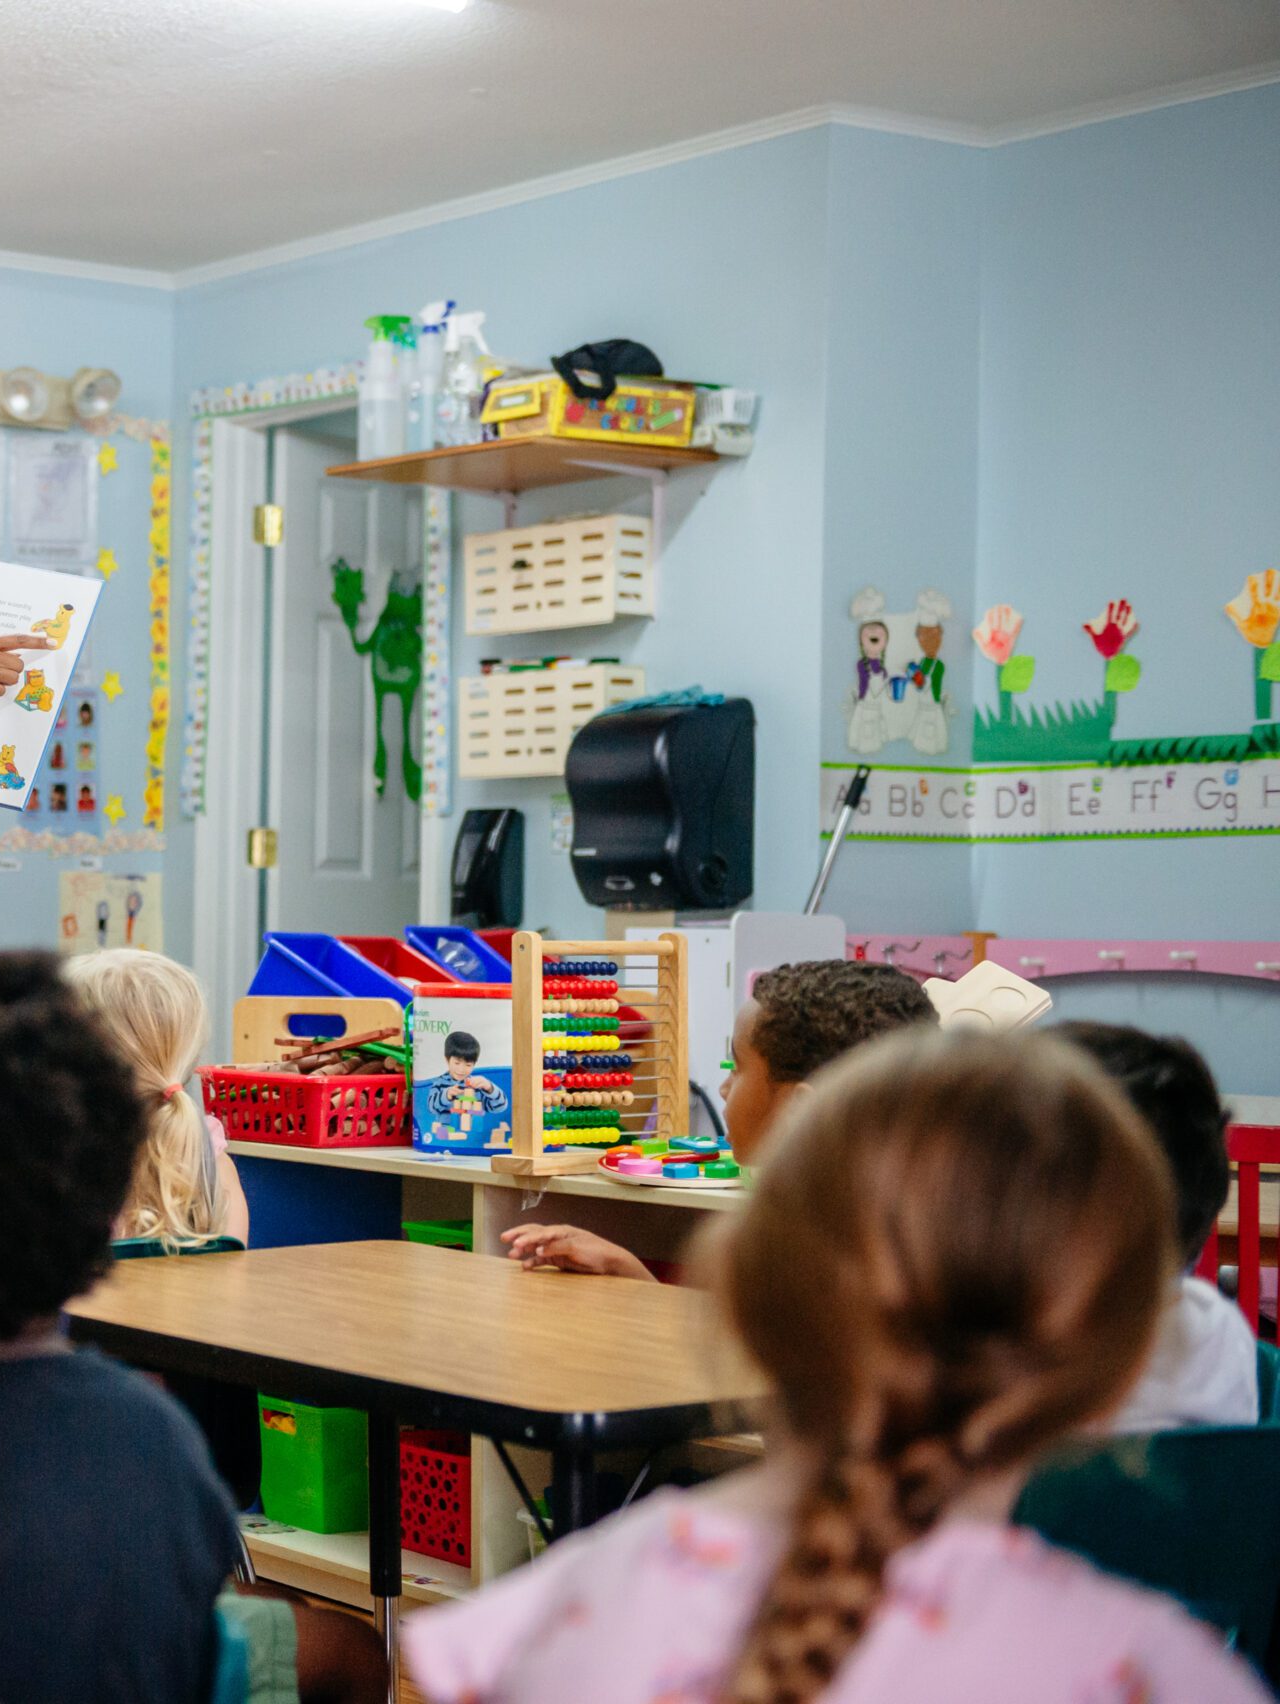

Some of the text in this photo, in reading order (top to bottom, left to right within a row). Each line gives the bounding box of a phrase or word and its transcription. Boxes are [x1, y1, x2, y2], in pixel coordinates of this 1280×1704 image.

[888, 784, 924, 818] Bb
[940, 787, 975, 819] Cc
[995, 786, 1036, 819] Dd
[1068, 782, 1101, 816] Ee
[1131, 780, 1163, 812] Ff
[1195, 777, 1238, 823] Gg
